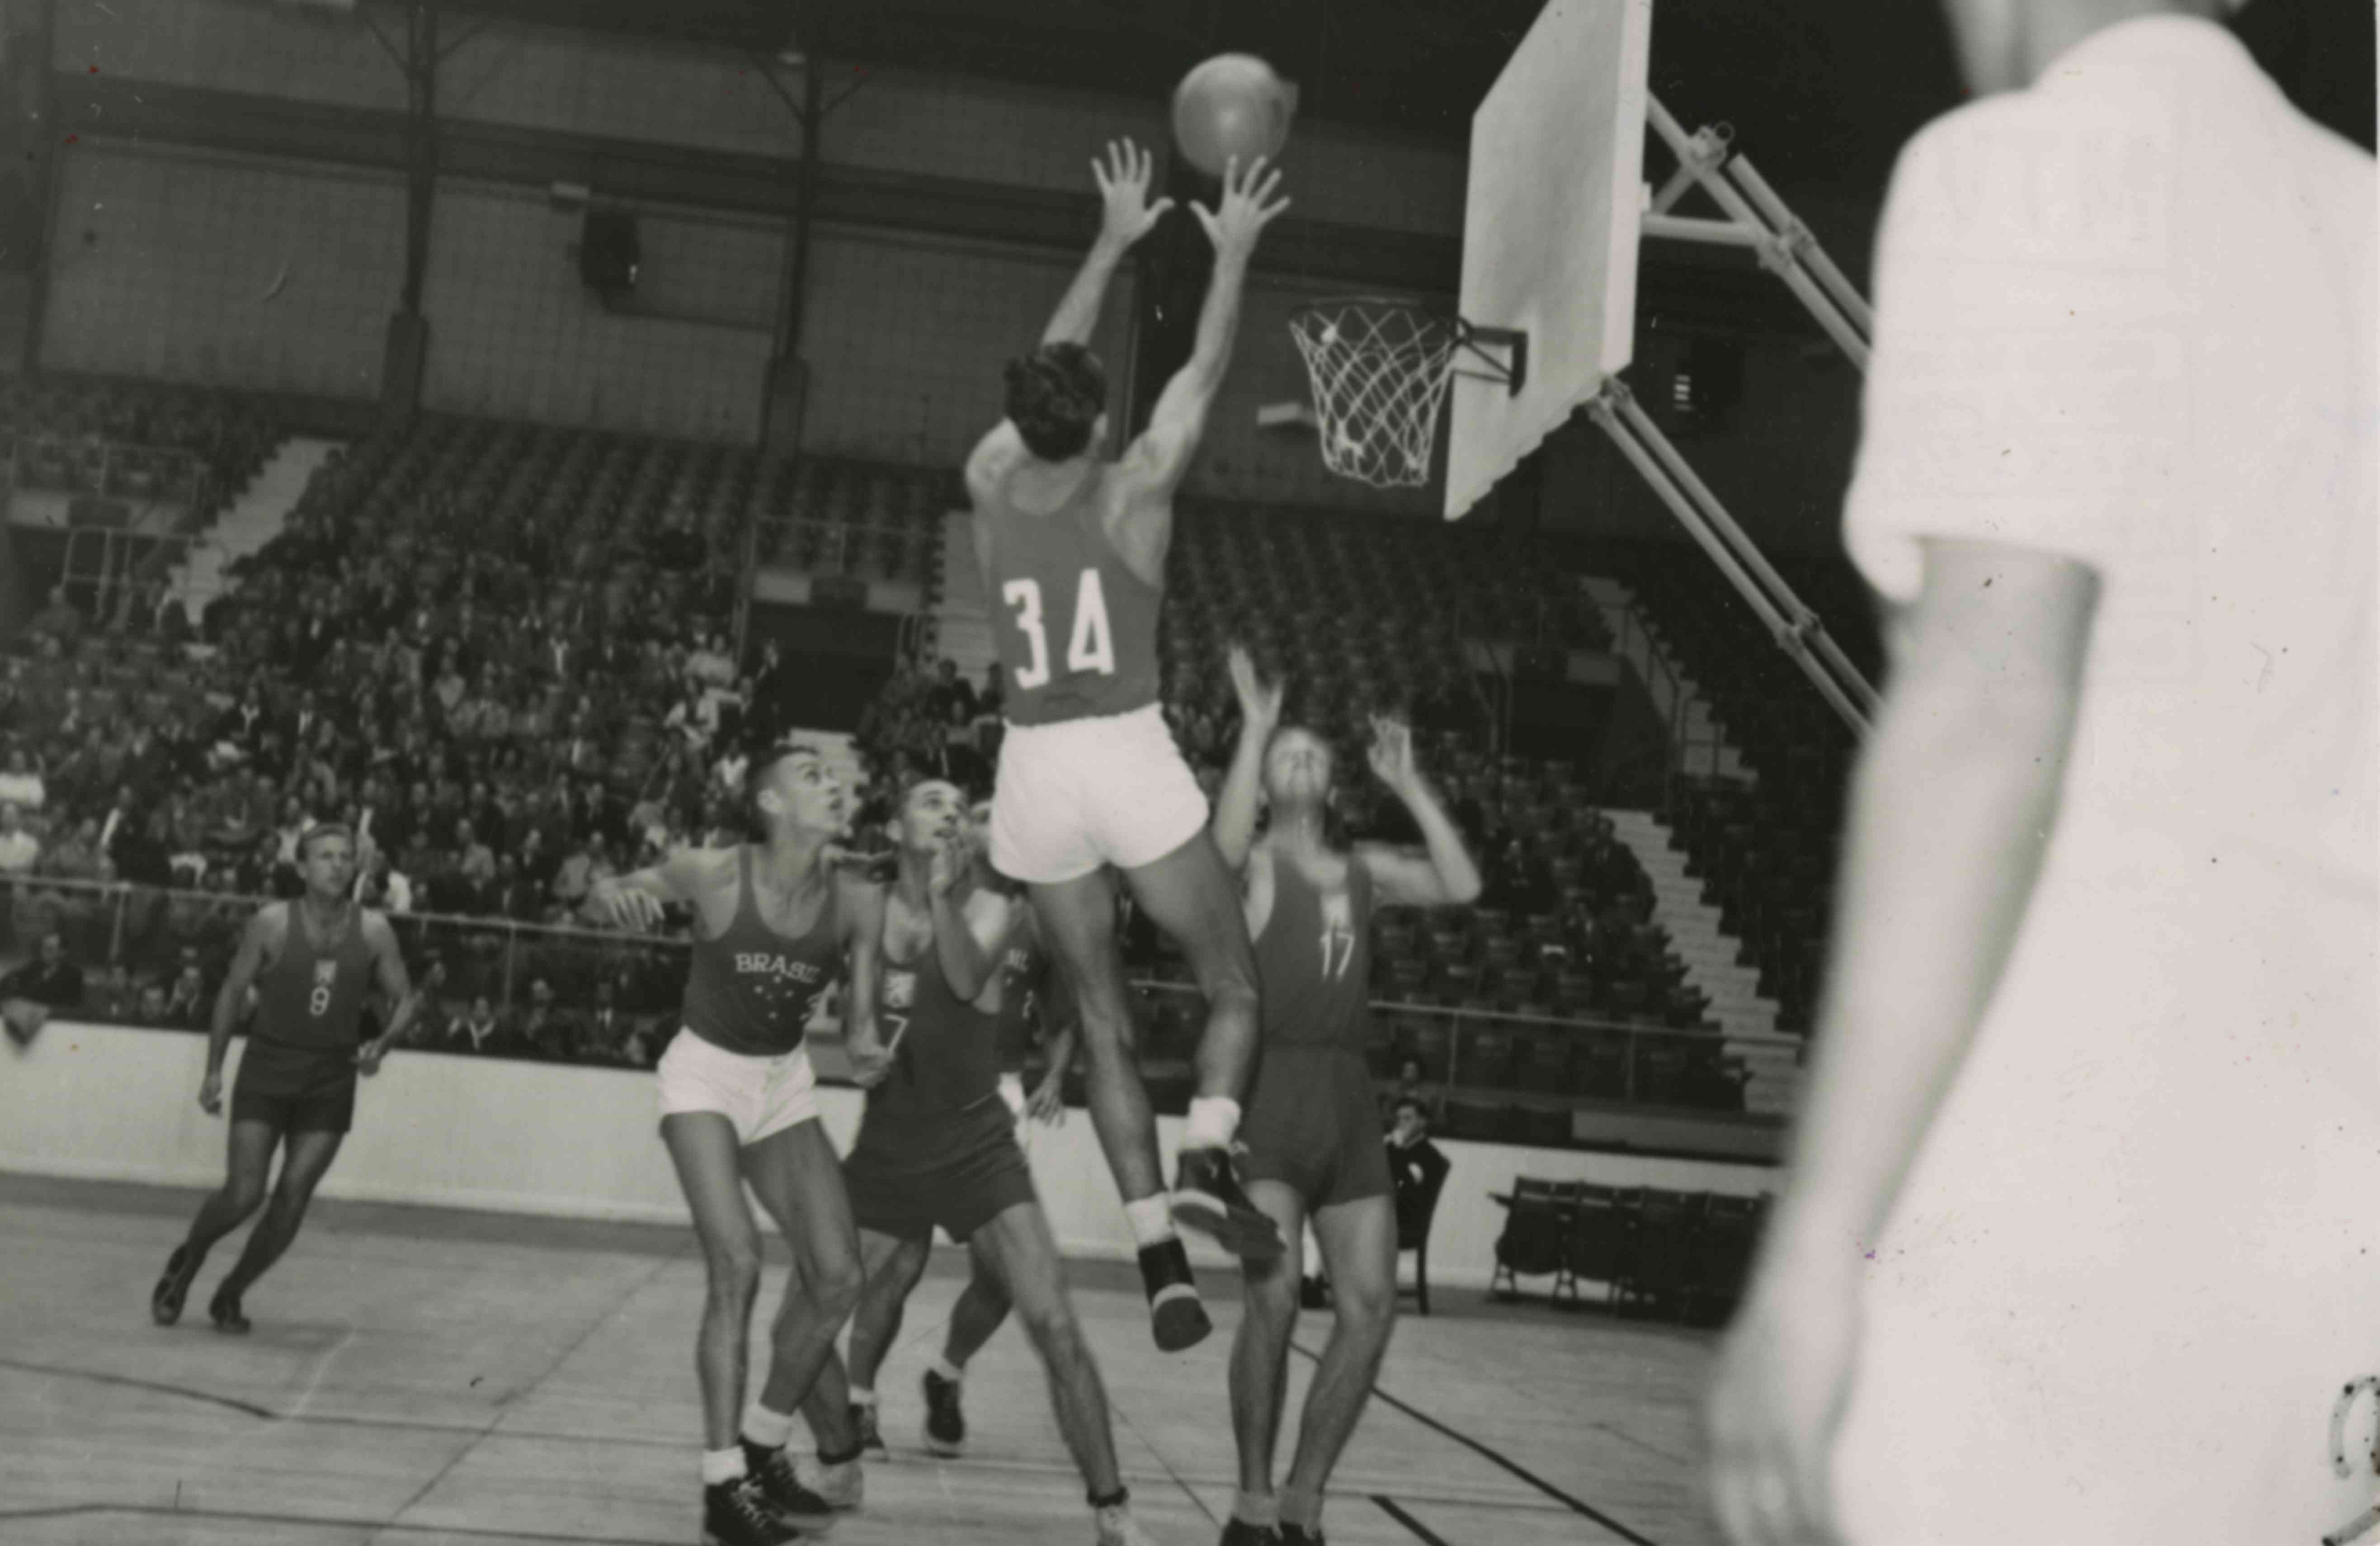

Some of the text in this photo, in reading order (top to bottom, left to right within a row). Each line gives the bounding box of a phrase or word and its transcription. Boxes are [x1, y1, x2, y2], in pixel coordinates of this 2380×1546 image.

[1002, 567, 1115, 690] 34
[1319, 930, 1354, 983] 17
[883, 1013, 909, 1055] 7
